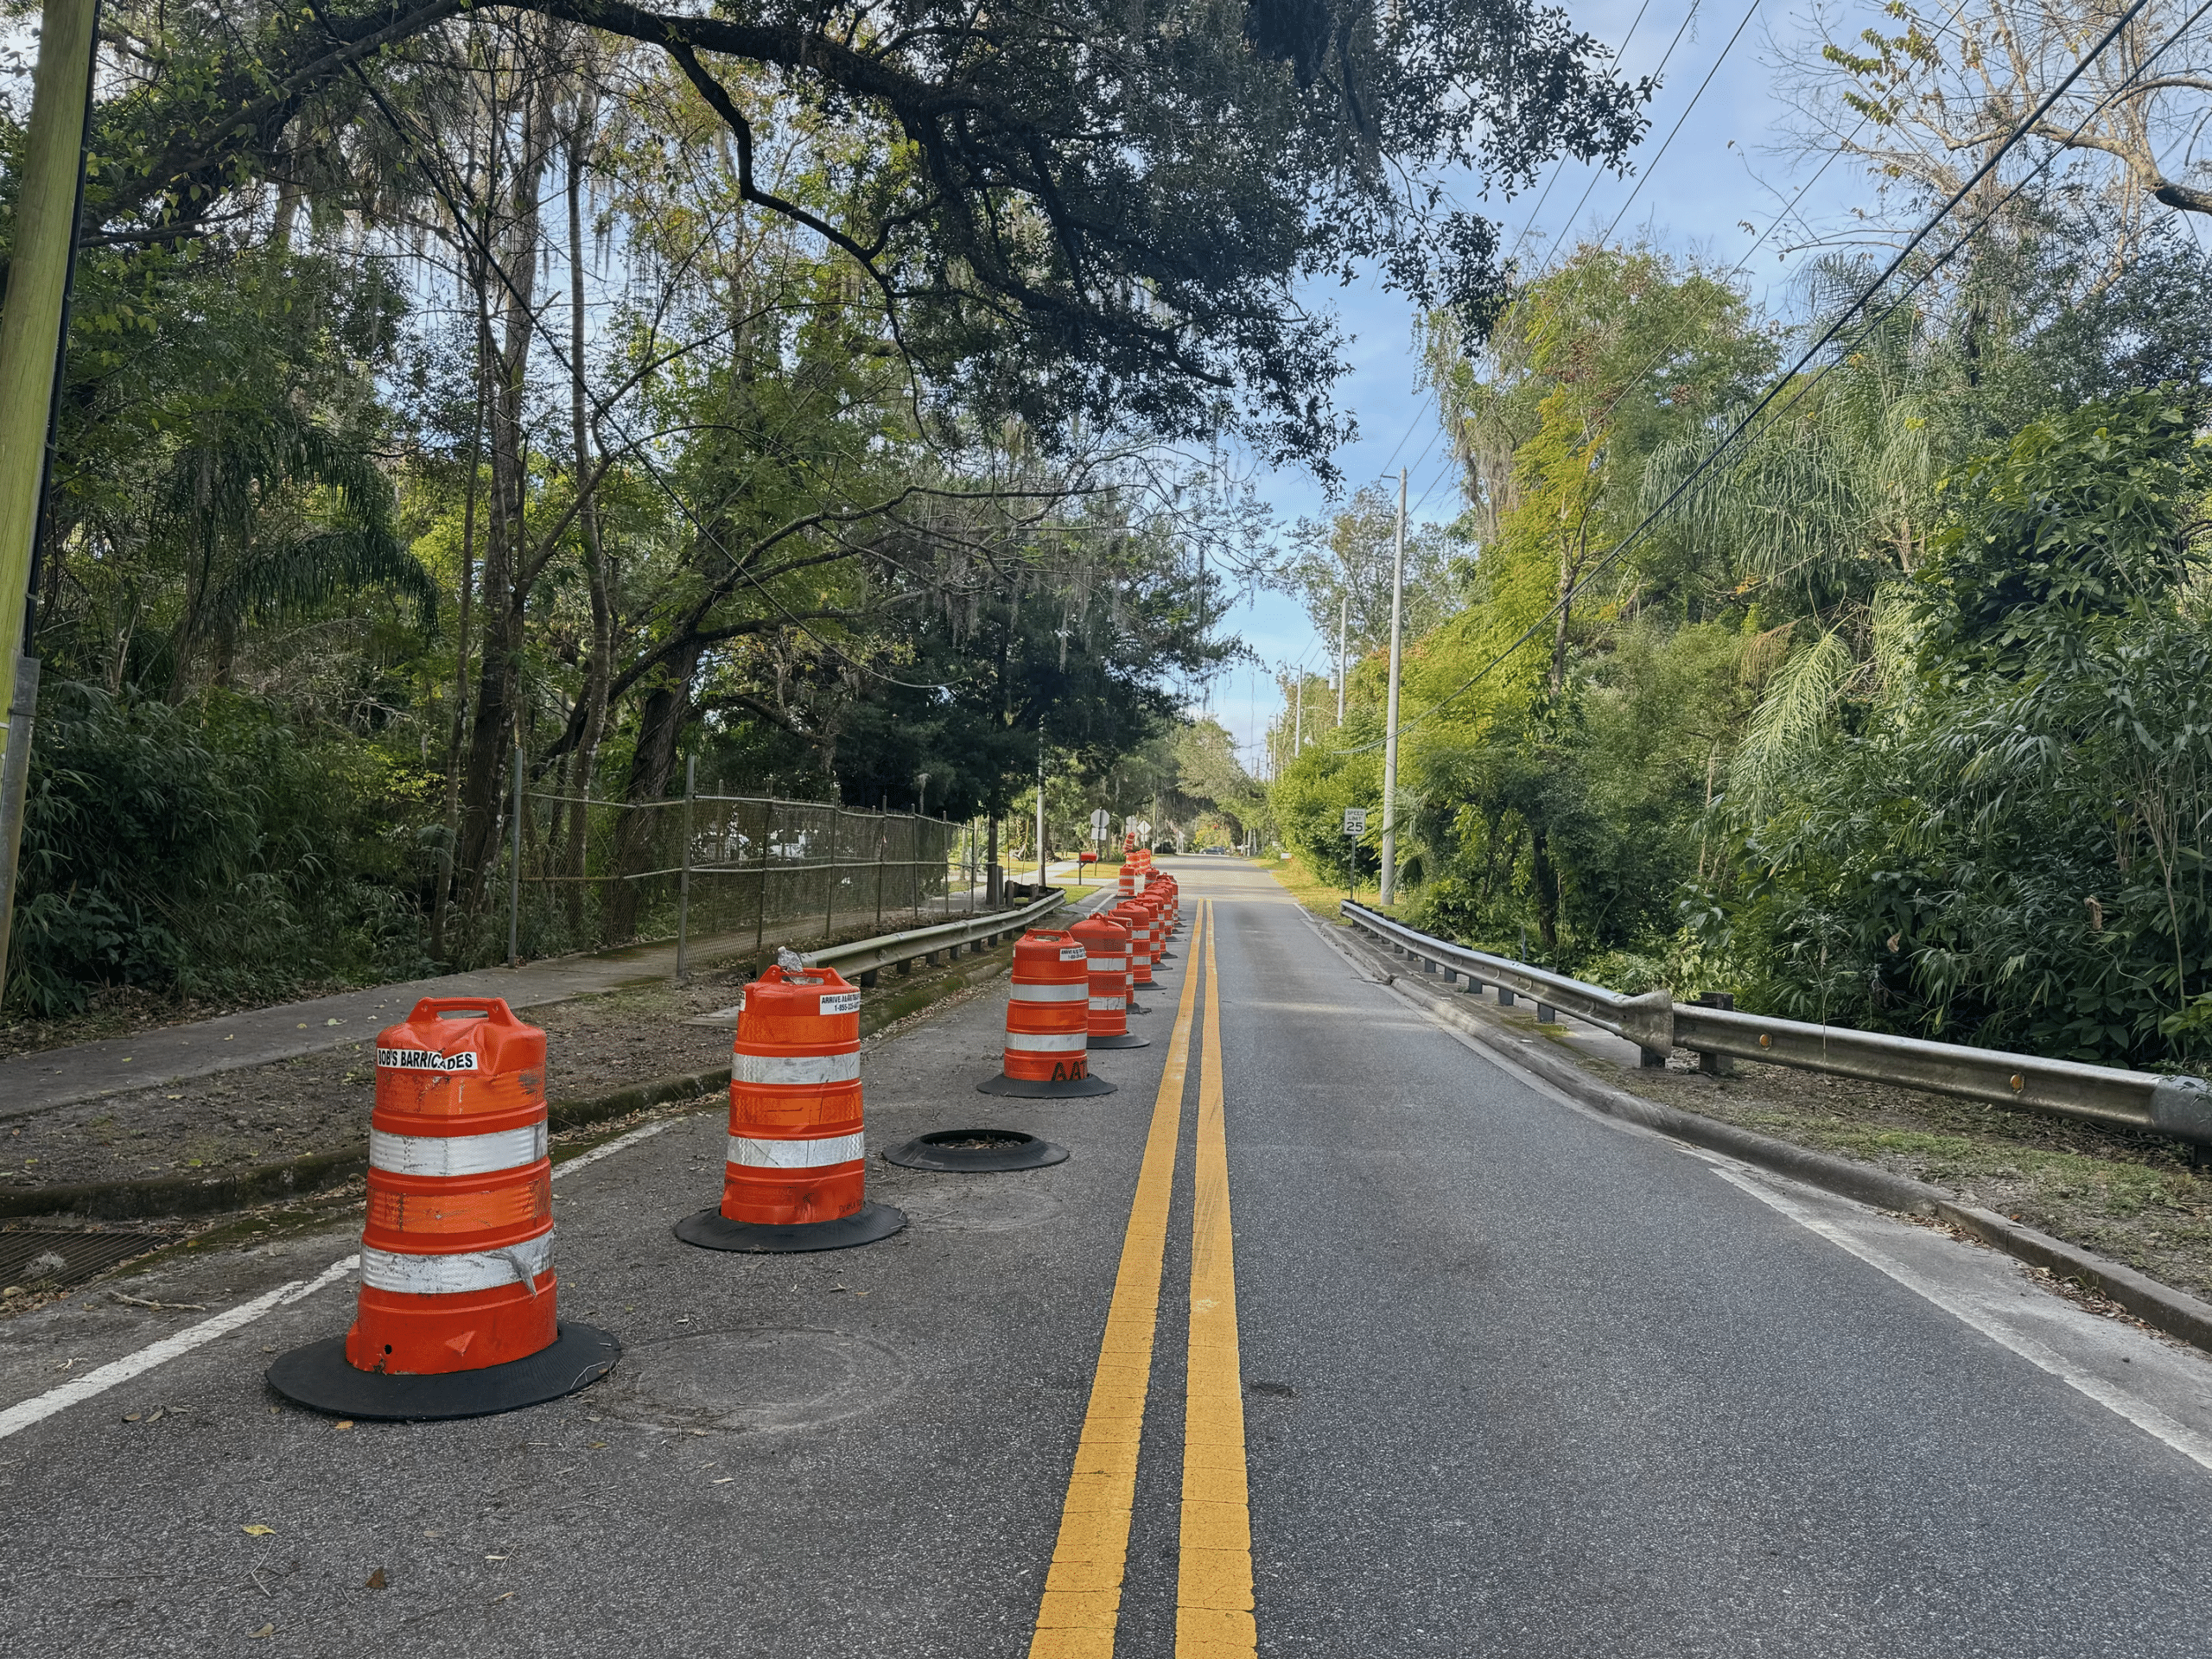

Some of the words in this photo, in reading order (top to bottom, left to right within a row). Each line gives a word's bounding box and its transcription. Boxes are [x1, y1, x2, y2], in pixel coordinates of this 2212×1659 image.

[1346, 822, 1363, 832] 25
[822, 995, 841, 1004] ARRIVE
[400, 1051, 474, 1071] BARRICADES
